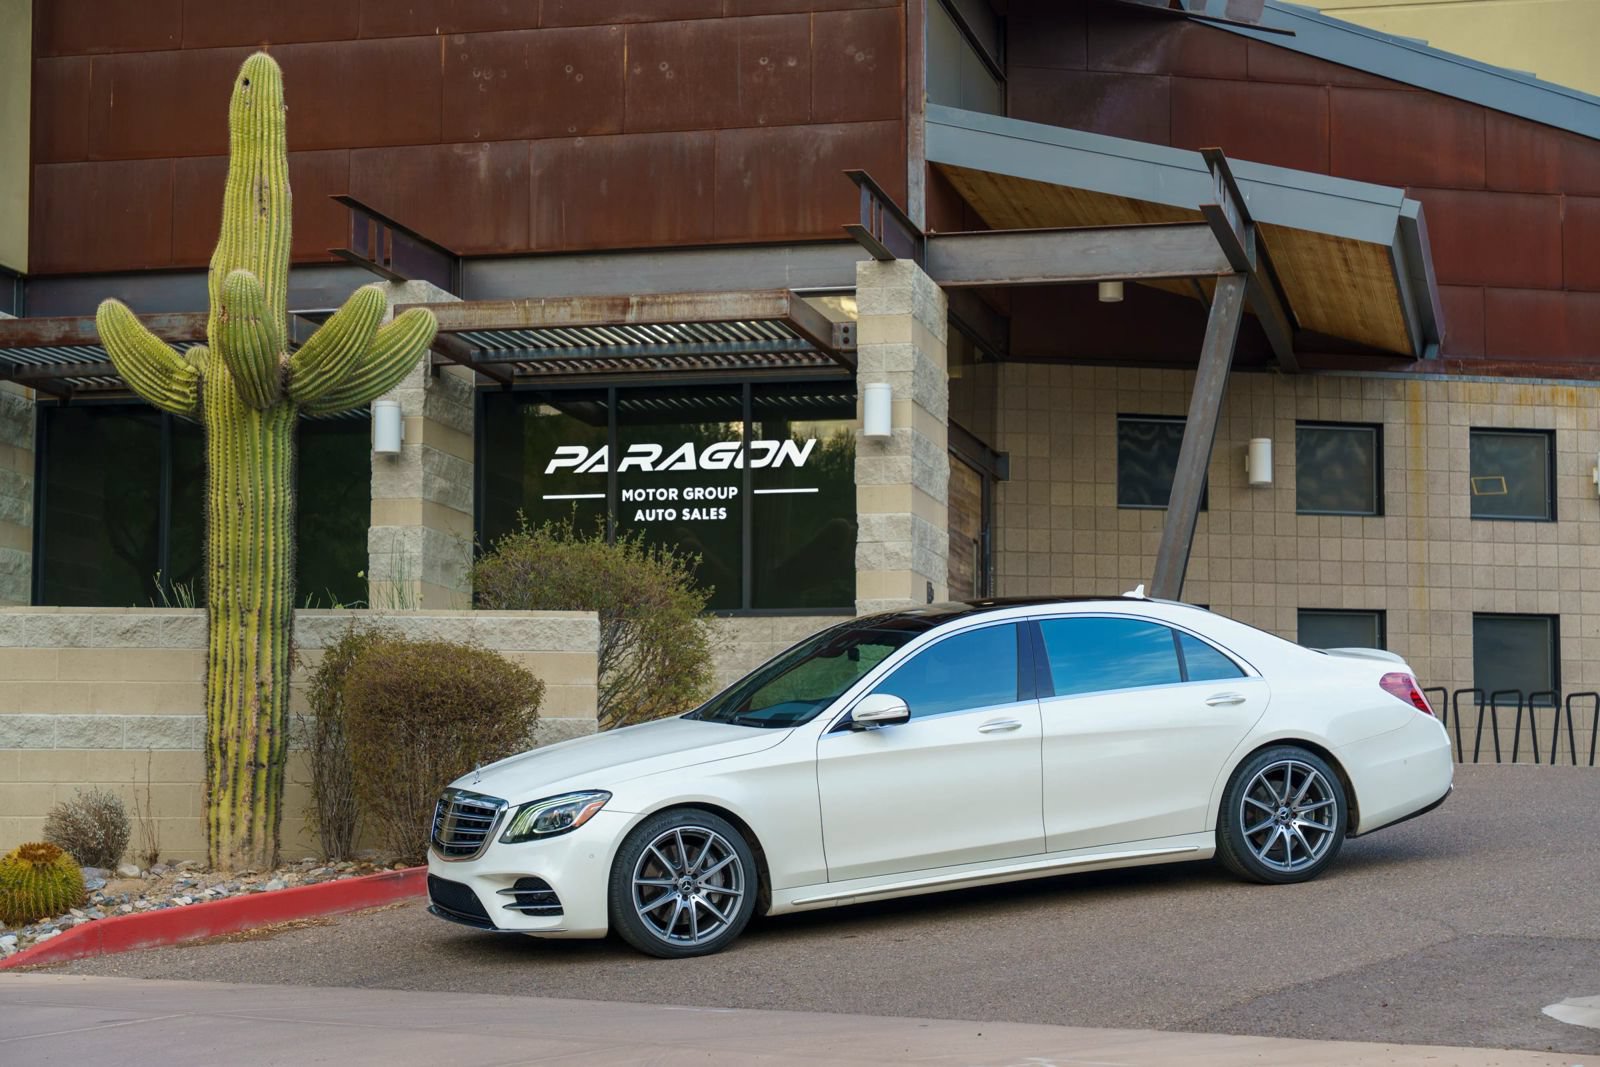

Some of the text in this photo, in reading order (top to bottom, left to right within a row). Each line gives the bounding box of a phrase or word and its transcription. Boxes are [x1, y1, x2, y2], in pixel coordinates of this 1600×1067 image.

[545, 437, 817, 474] PARAGON
[622, 487, 738, 502] MOTOR GROUP
[634, 508, 727, 522] AUTO SALES
